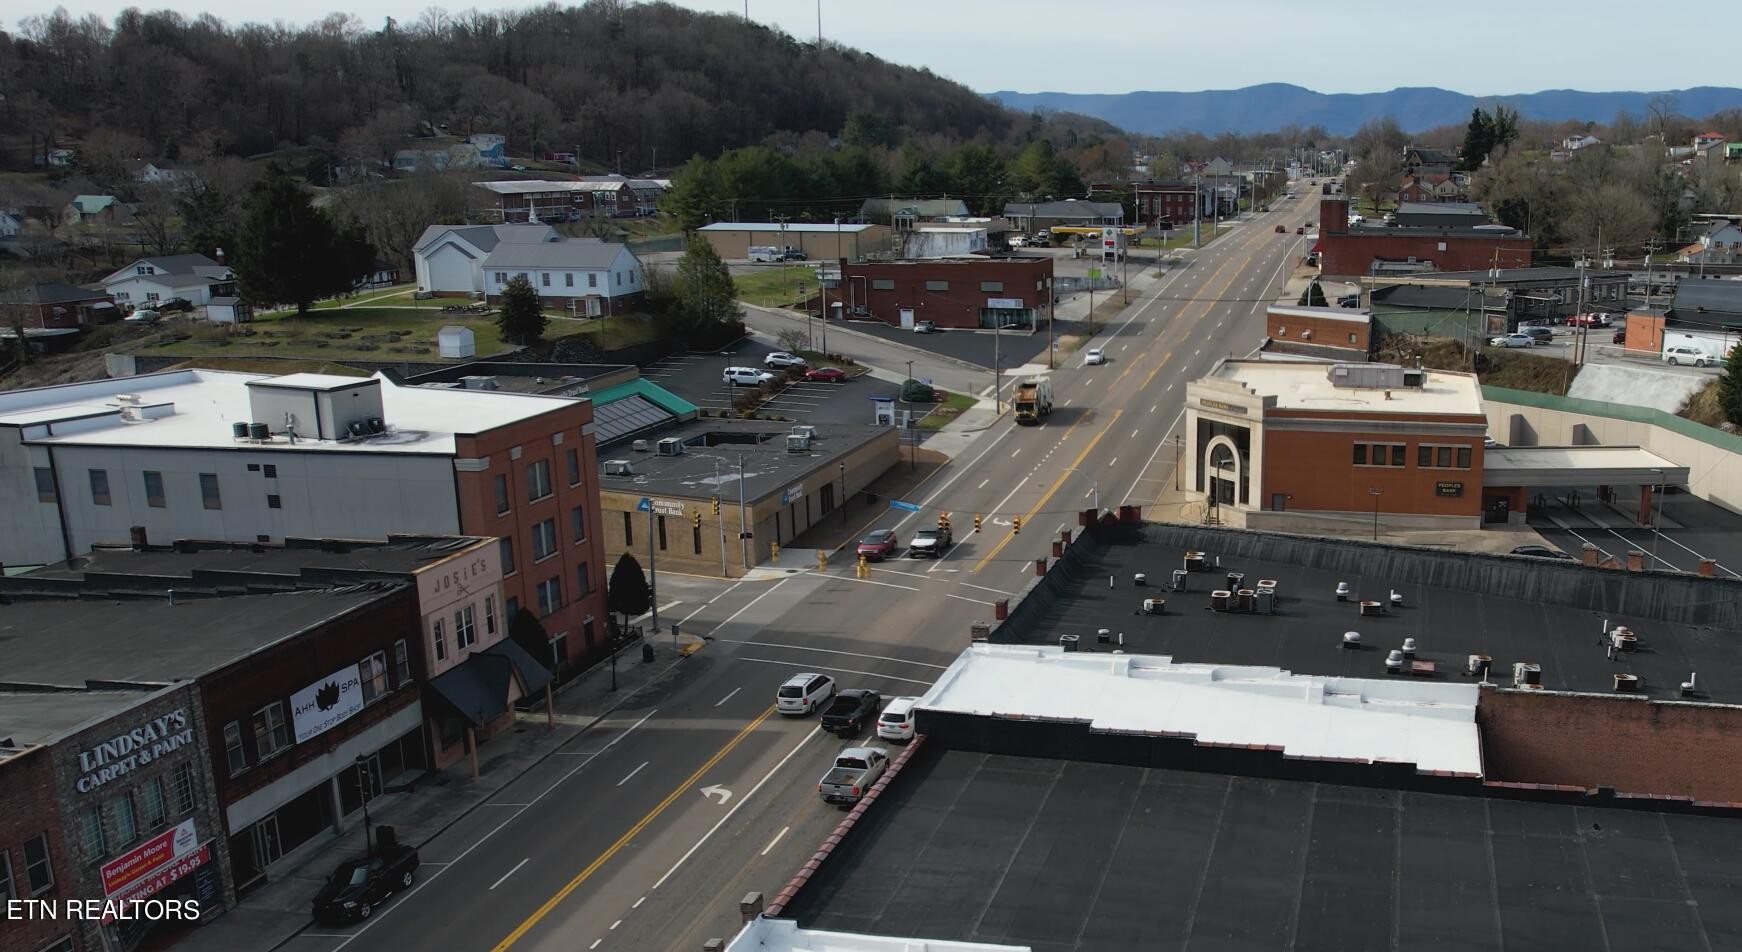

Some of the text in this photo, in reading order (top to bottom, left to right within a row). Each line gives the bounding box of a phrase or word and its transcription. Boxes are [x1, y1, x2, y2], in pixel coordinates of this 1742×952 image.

[295, 678, 360, 717] AHH SPA
[76, 728, 193, 793] CARPET & PAINT
[78, 708, 186, 774] LINDSAY'S
[106, 840, 168, 879] Benjamin Moore
[156, 876, 167, 890] AT
